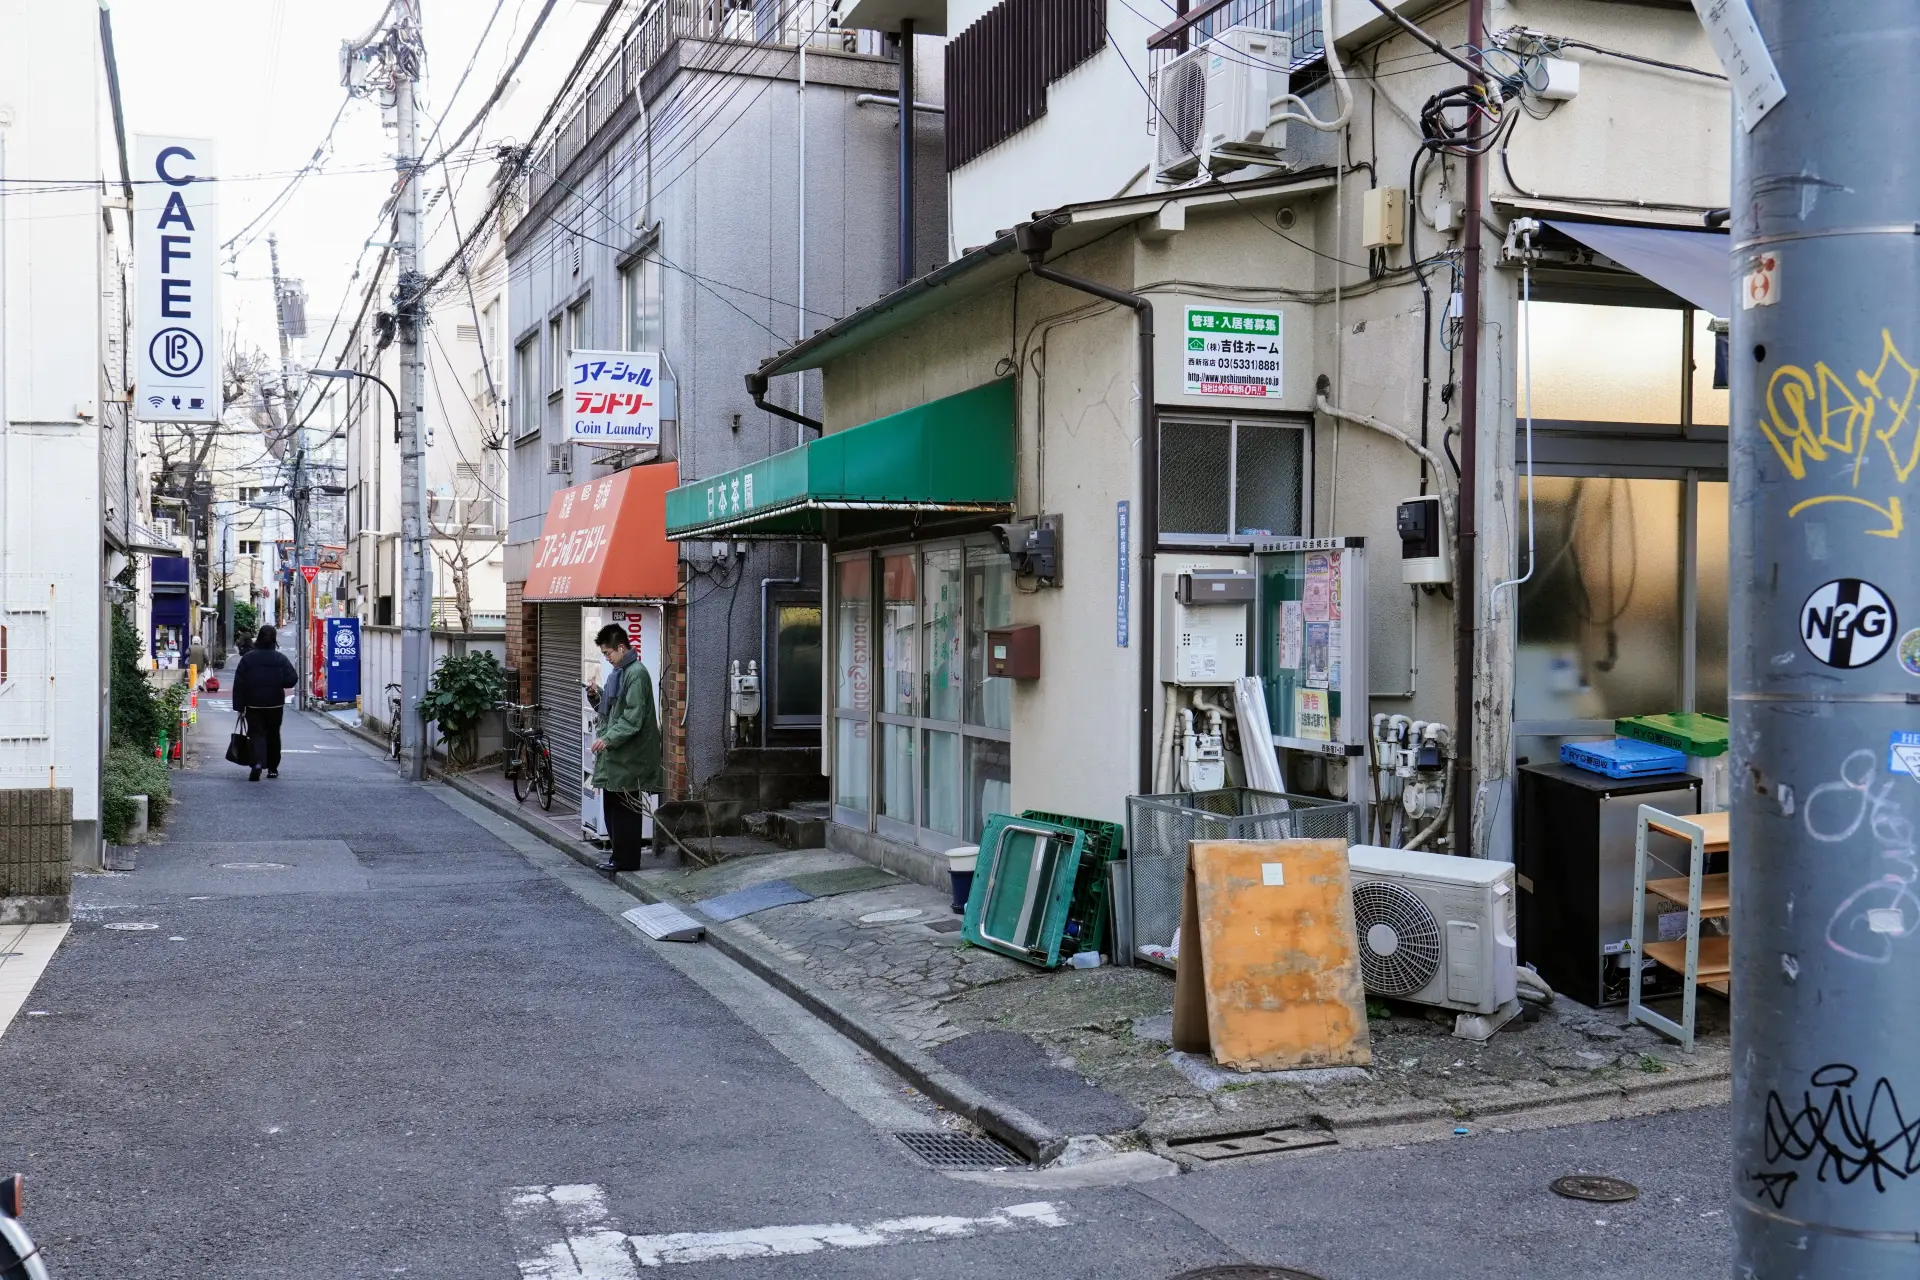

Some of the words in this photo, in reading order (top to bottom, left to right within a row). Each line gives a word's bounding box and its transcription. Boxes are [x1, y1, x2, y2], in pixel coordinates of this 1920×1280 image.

[155, 146, 196, 319] CAFE
[1191, 315, 1277, 331] 管理・入居者募集
[574, 361, 653, 387] コマーシャル
[1188, 358, 1216, 366] 西新宿店
[1218, 358, 1280, 371] 03(5331)8881
[575, 392, 653, 415] ランドリー
[575, 420, 601, 434] Coin
[606, 421, 653, 439] Laundry
[625, 613, 641, 662] POKK
[334, 647, 356, 655] BOSS
